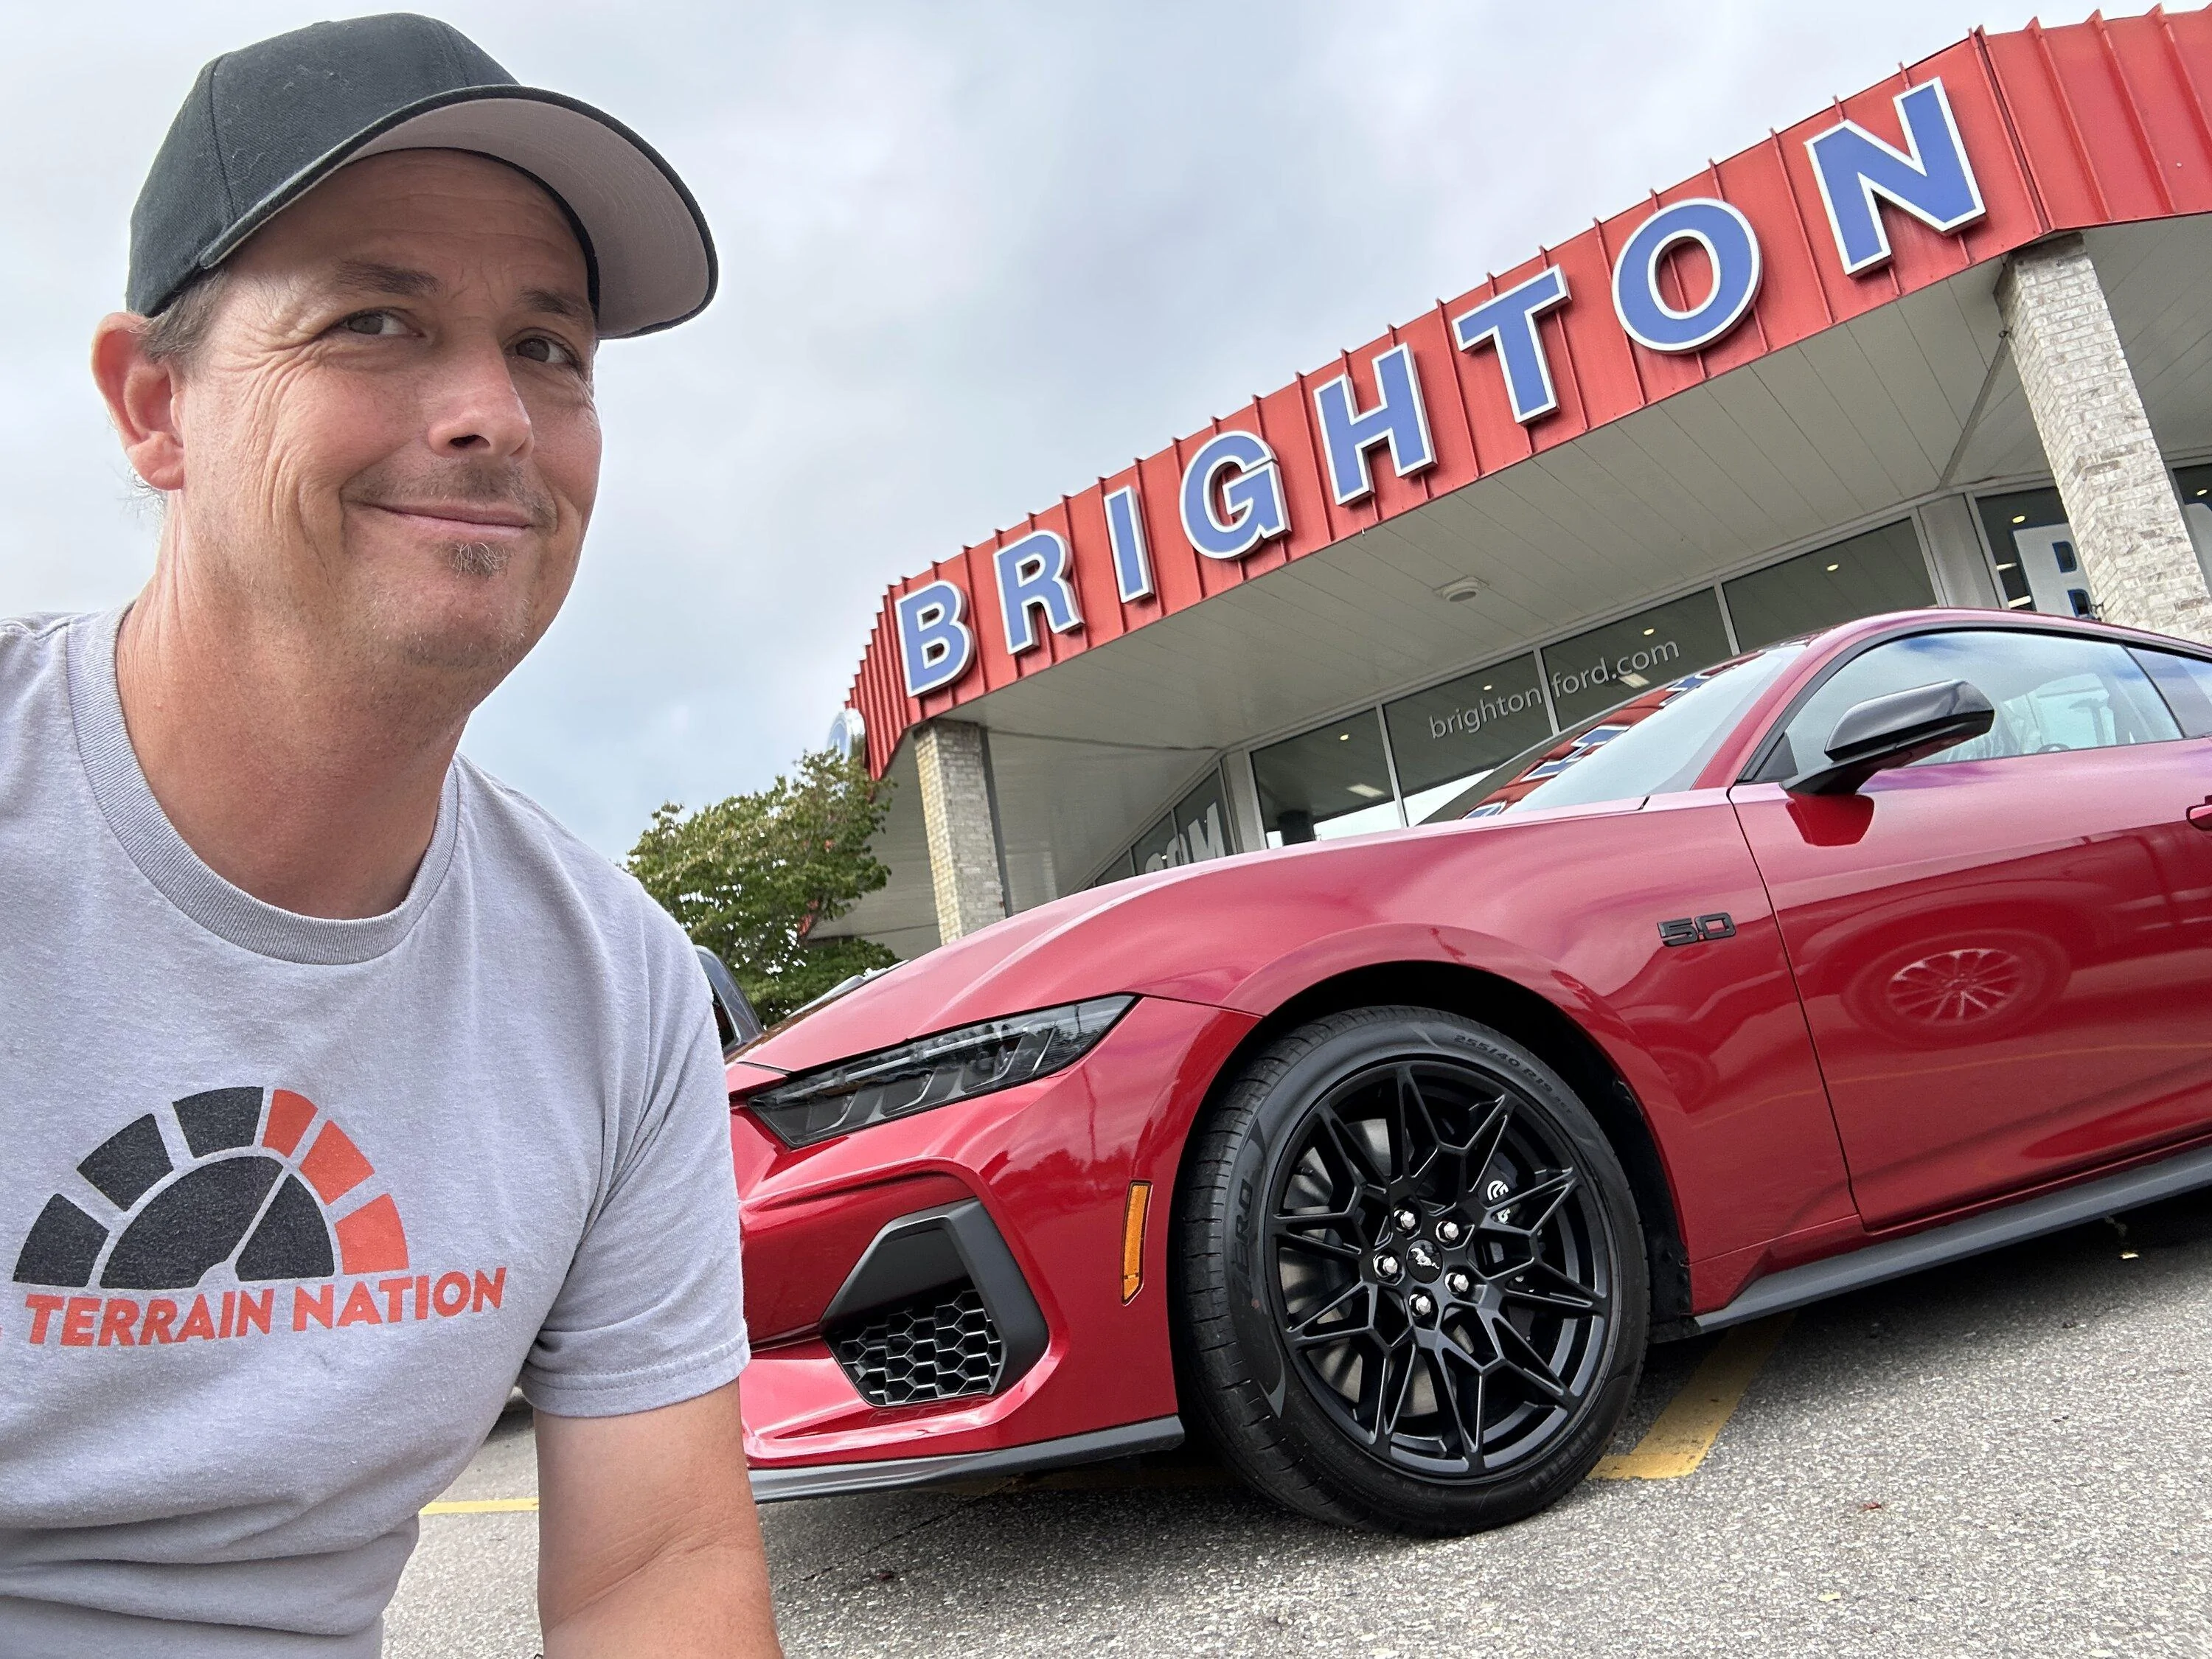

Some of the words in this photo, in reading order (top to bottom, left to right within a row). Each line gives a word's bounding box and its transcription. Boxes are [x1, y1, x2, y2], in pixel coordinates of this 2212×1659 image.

[894, 75, 1988, 698] BRIGHTON
[1453, 1034, 1521, 1067] 255/40
[24, 1288, 274, 1347] TERRAIN
[293, 1267, 507, 1332] NATION
